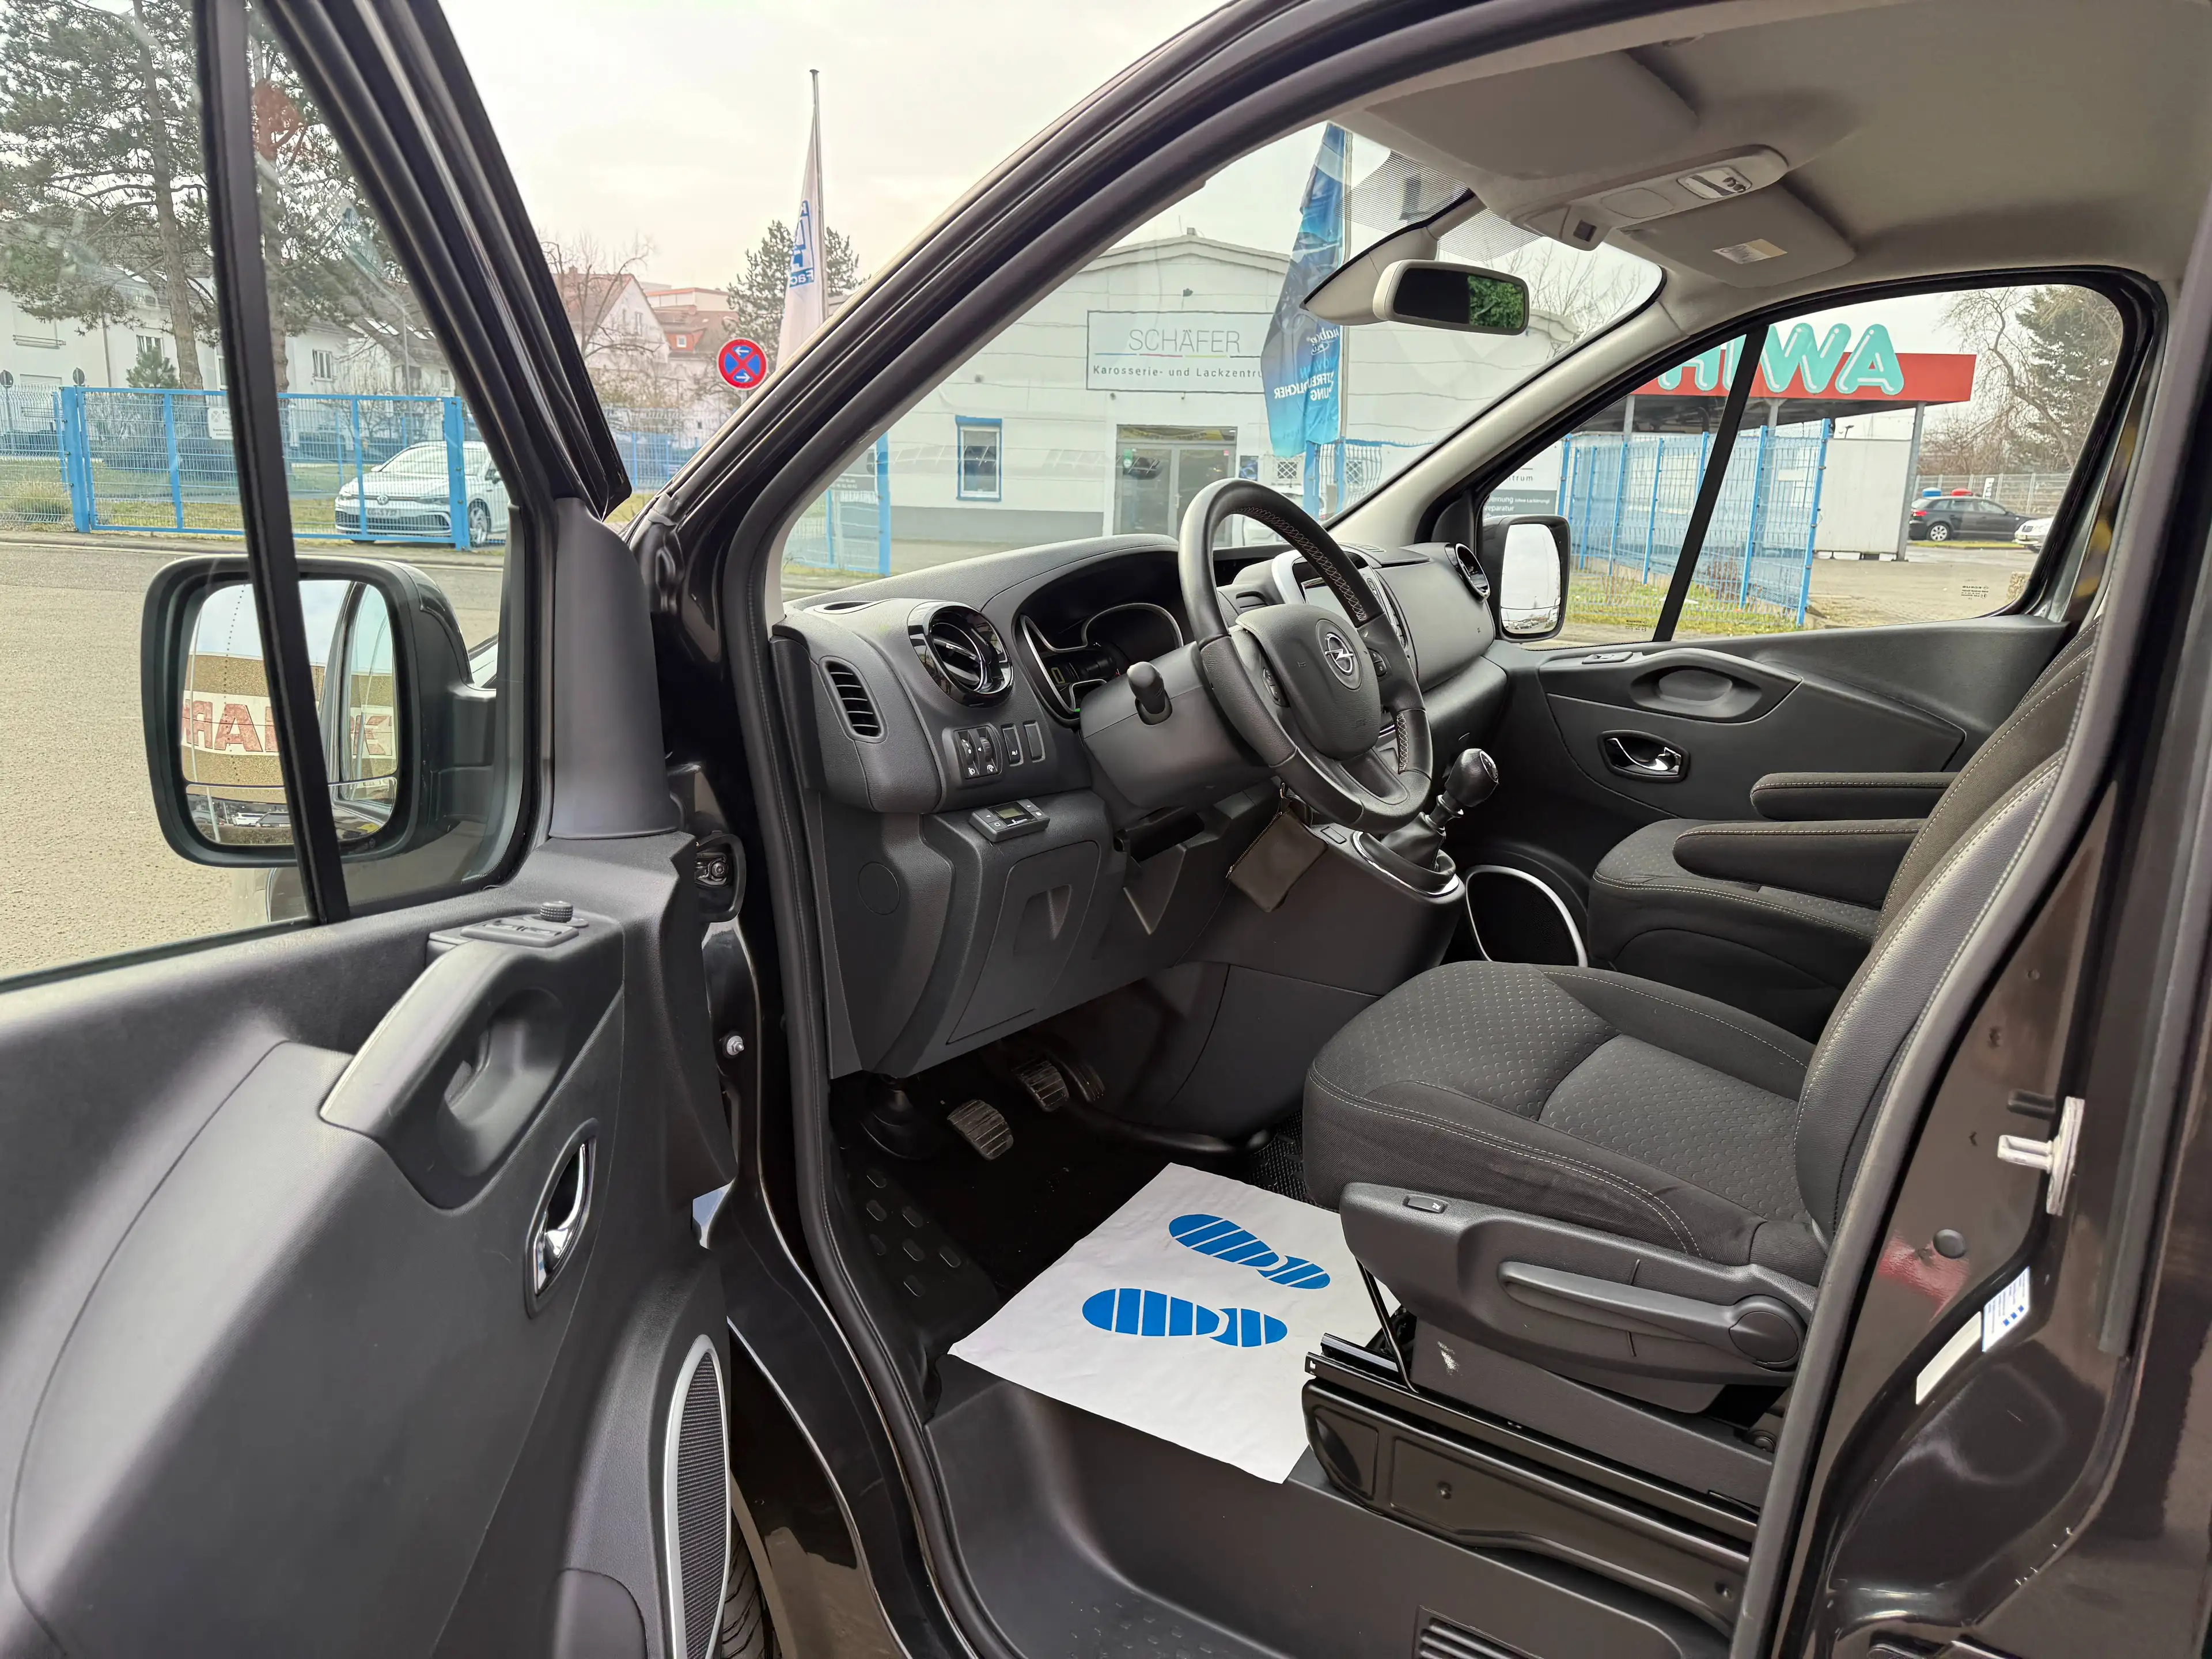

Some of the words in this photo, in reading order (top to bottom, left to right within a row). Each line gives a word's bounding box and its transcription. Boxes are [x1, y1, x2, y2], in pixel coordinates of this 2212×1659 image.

[1128, 328, 1240, 353] SCHÄFER
[1093, 365, 1163, 376] Karosserie-
[1169, 368, 1190, 377] und
